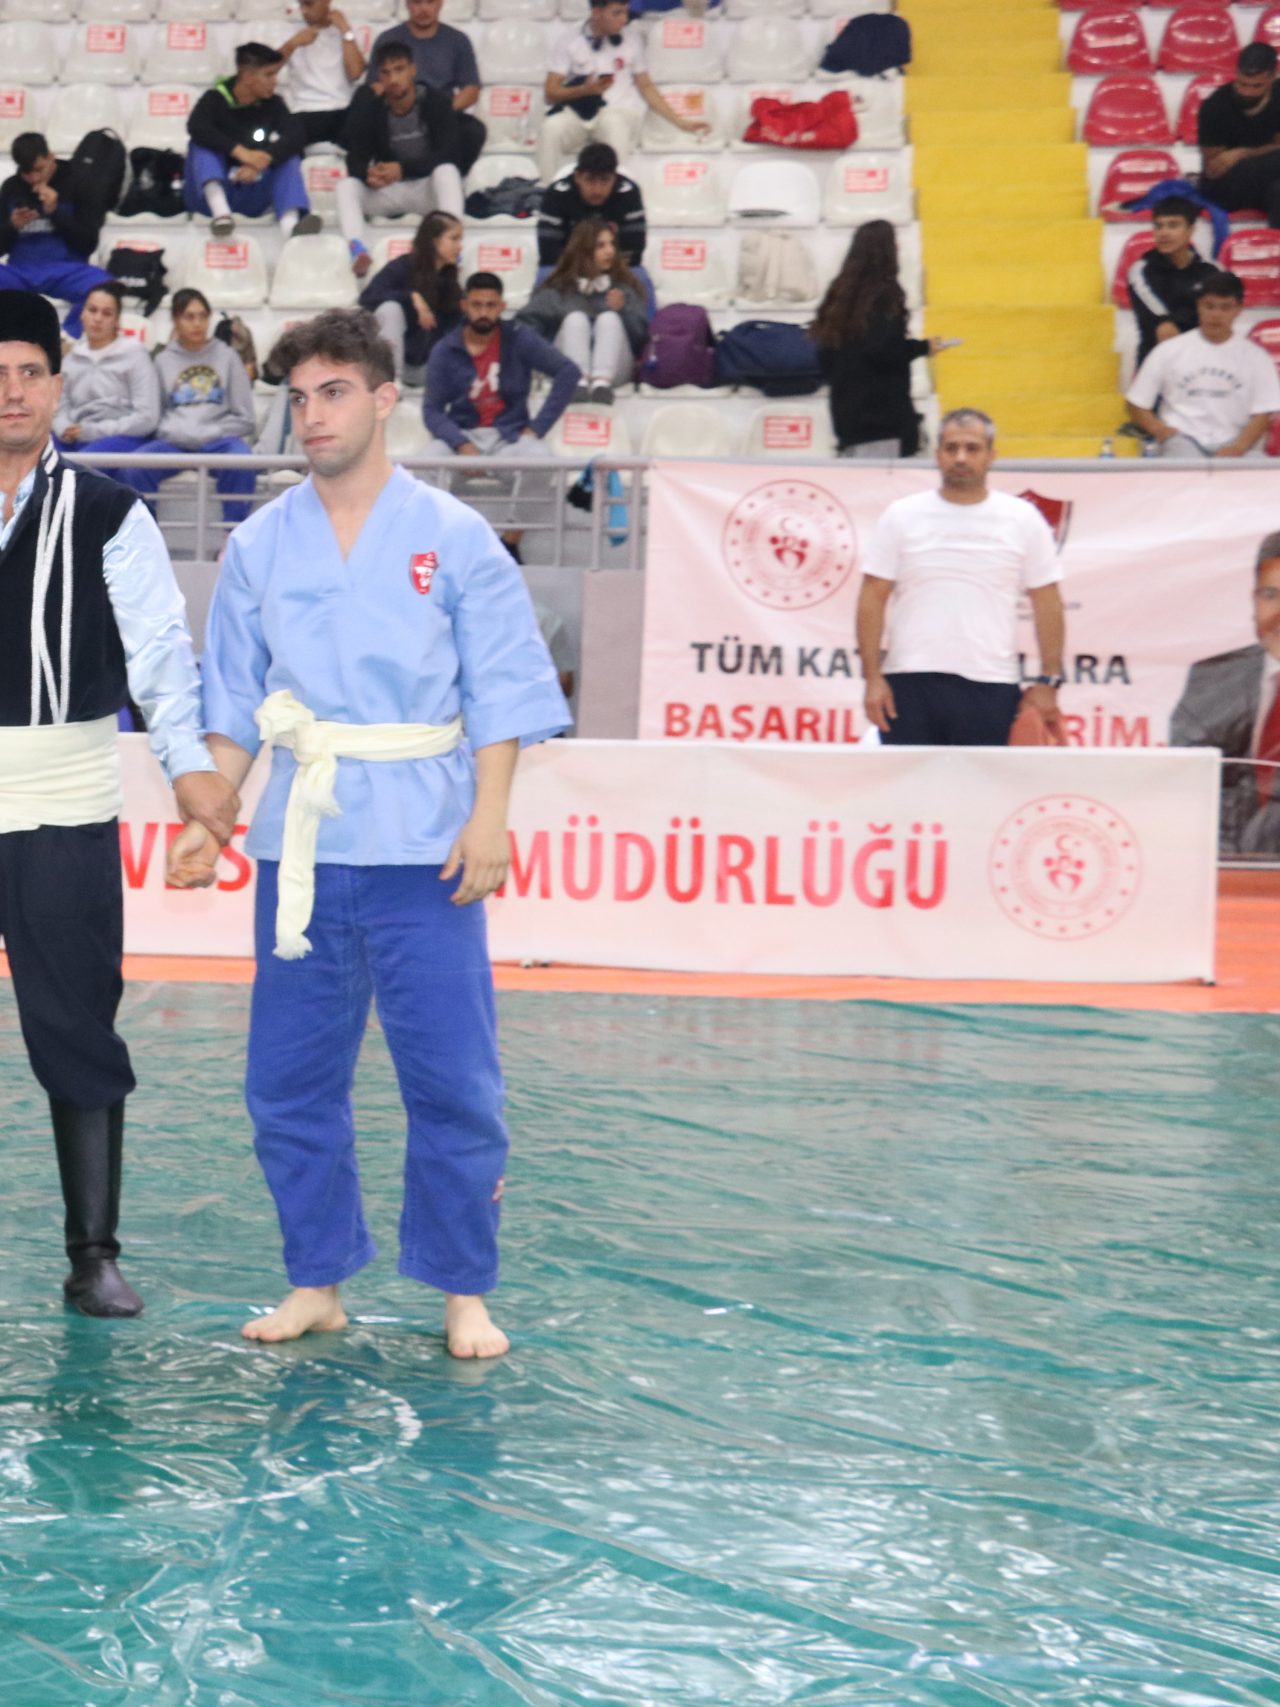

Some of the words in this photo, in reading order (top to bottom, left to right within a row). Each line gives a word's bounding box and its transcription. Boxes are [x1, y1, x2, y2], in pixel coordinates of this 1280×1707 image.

[690, 635, 783, 676] TÜM
[664, 702, 861, 744] BAŞARIL
[494, 814, 948, 910] MÜDÜRLÜĞÜ
